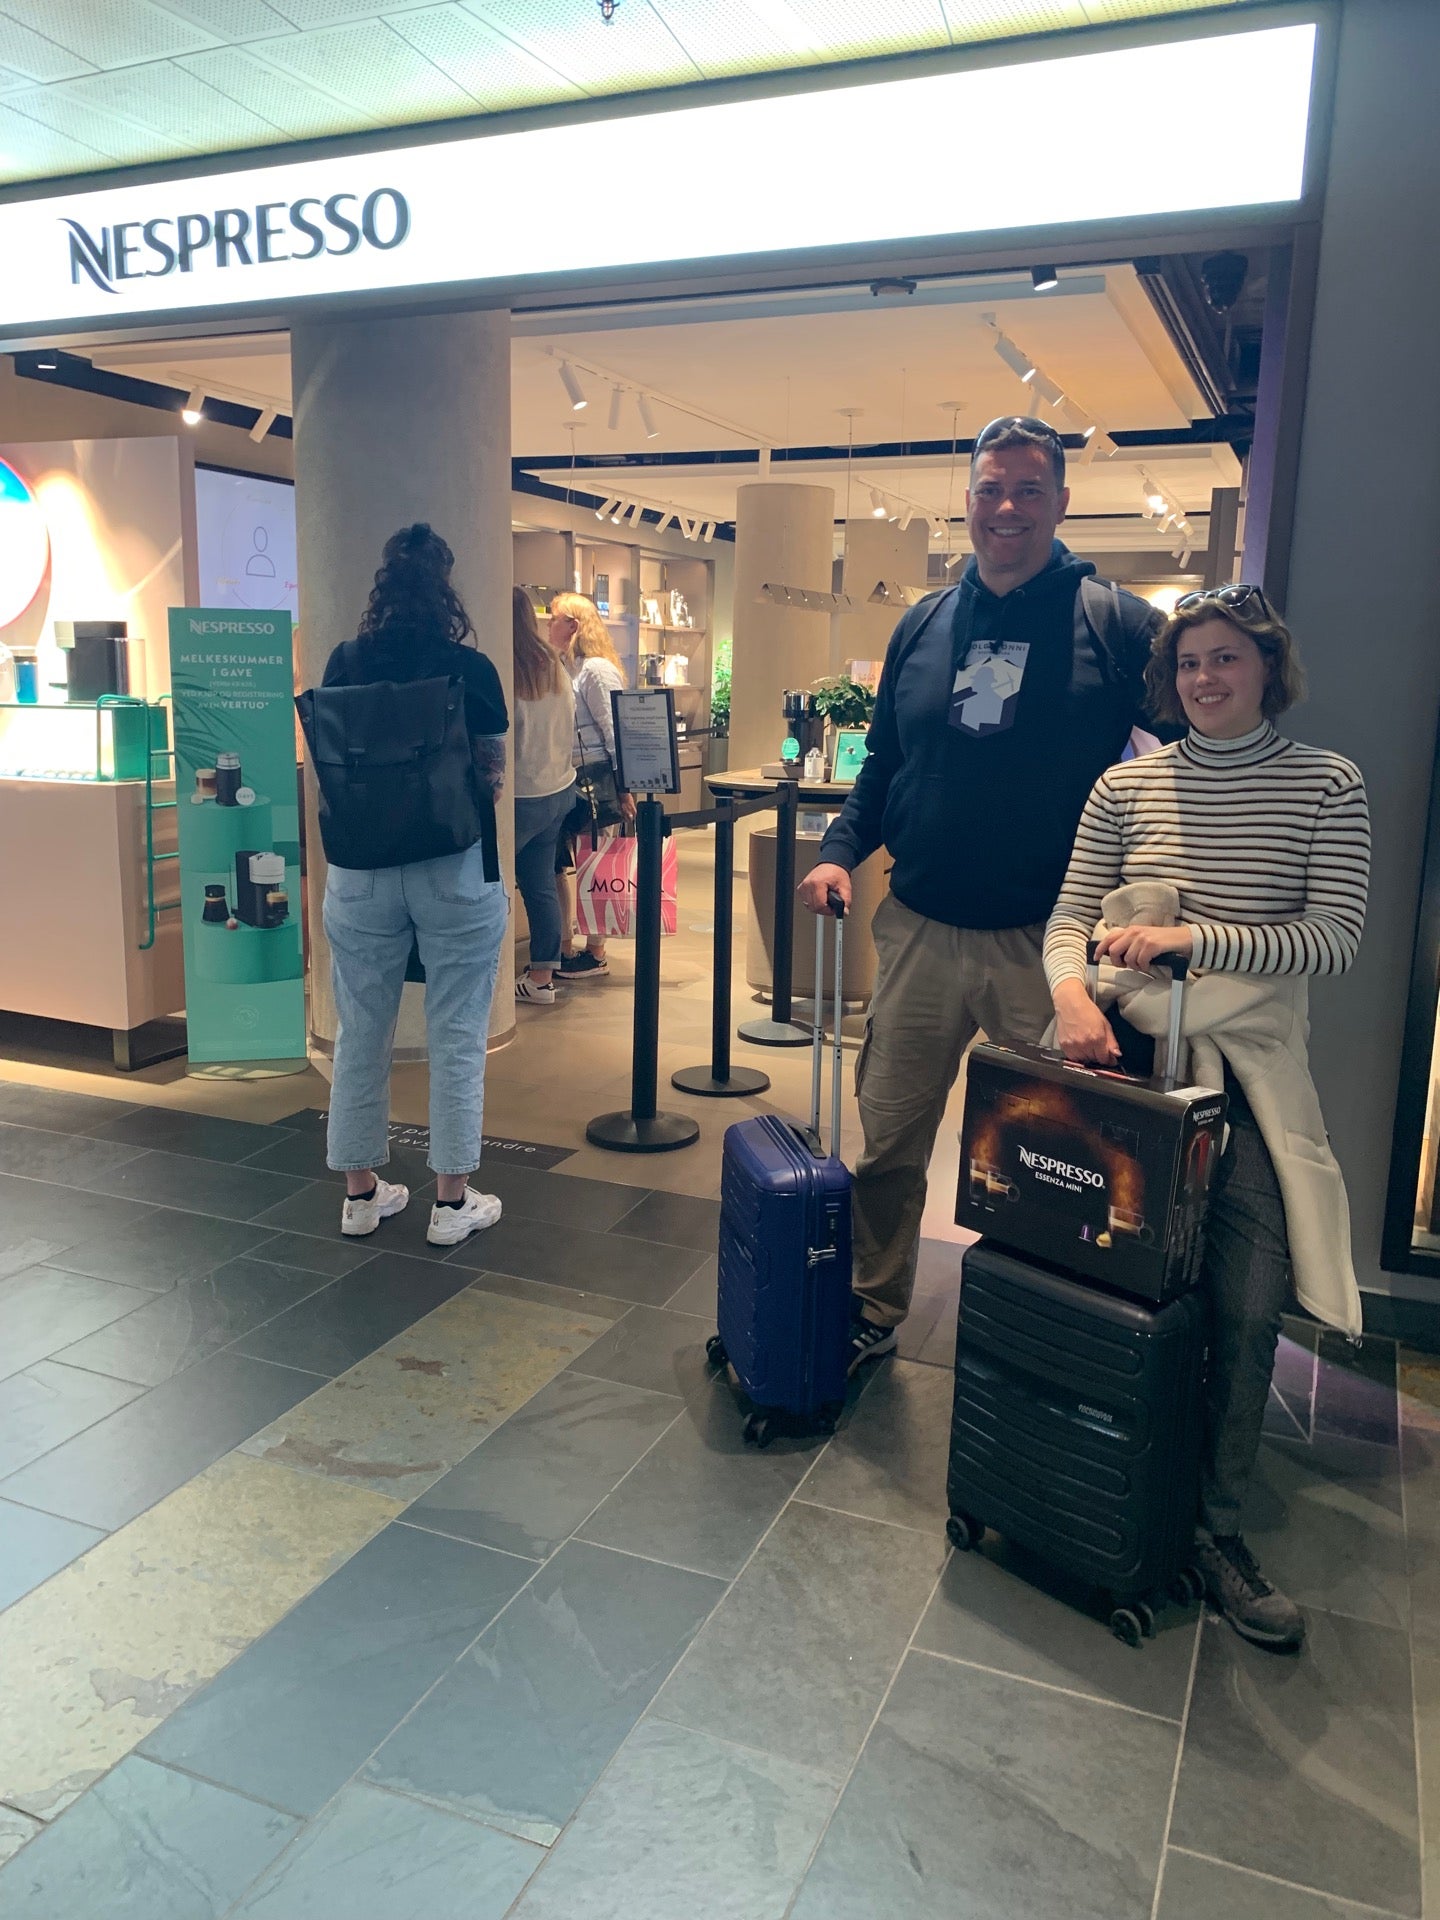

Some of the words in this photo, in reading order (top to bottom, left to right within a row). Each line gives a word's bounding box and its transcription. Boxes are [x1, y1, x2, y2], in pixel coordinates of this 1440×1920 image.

[57, 188, 411, 294] NESPRESSO
[189, 619, 275, 635] NESPRESSO
[180, 655, 284, 665] MELKESKUMMER
[212, 668, 217, 677] I
[221, 668, 253, 677] GAVE
[1193, 1106, 1221, 1122] NESPRESSO
[1017, 1144, 1104, 1188] NESPRESSO
[1034, 1171, 1065, 1188] ESSENZA
[1065, 1182, 1082, 1193] MINI
